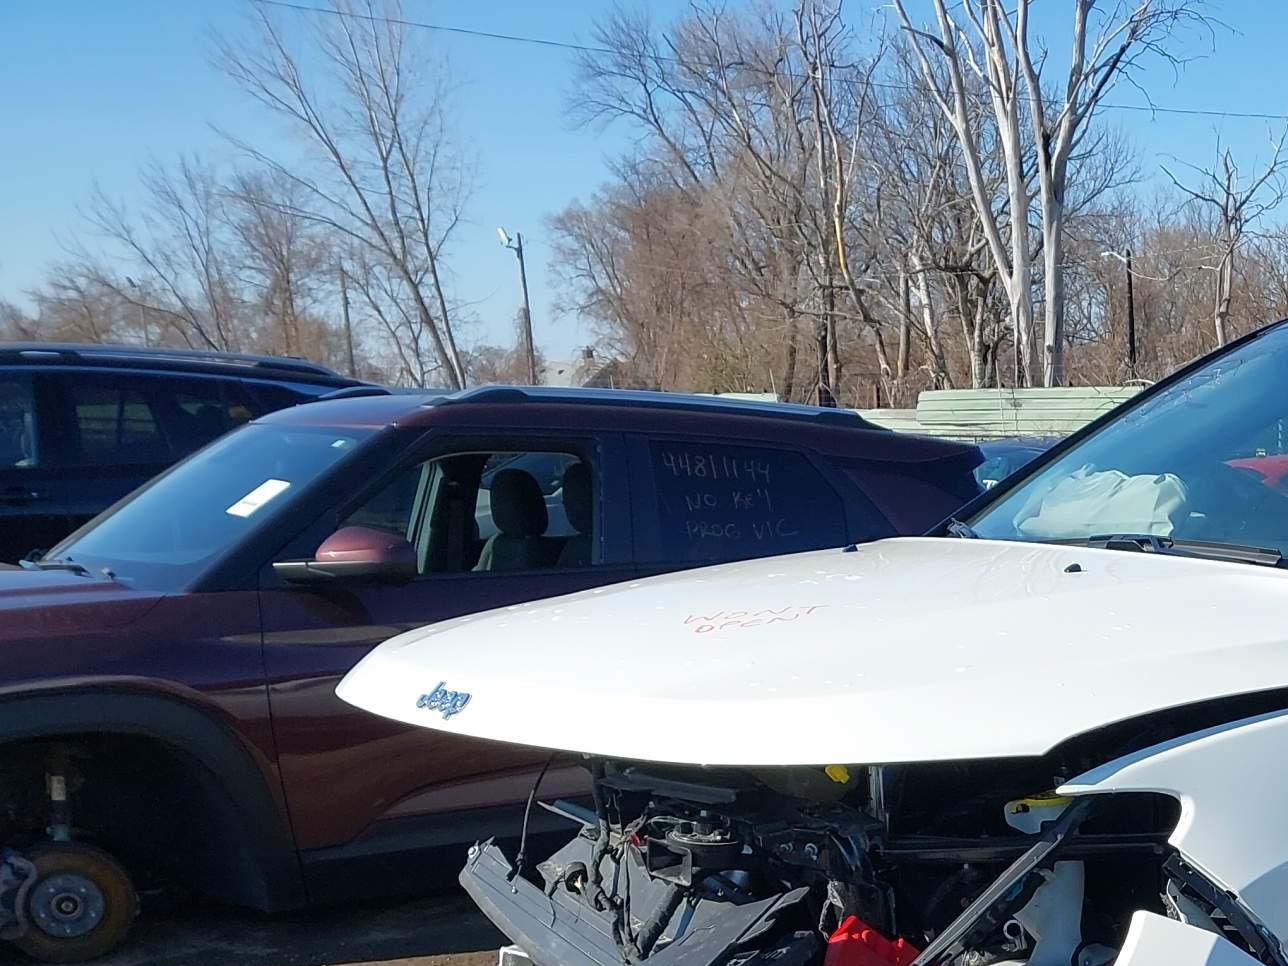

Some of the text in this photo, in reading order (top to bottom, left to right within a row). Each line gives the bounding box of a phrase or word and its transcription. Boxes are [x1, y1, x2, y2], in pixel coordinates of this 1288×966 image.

[661, 450, 771, 484] 44811144
[685, 491, 717, 512] NO
[416, 681, 471, 721] Jeep
